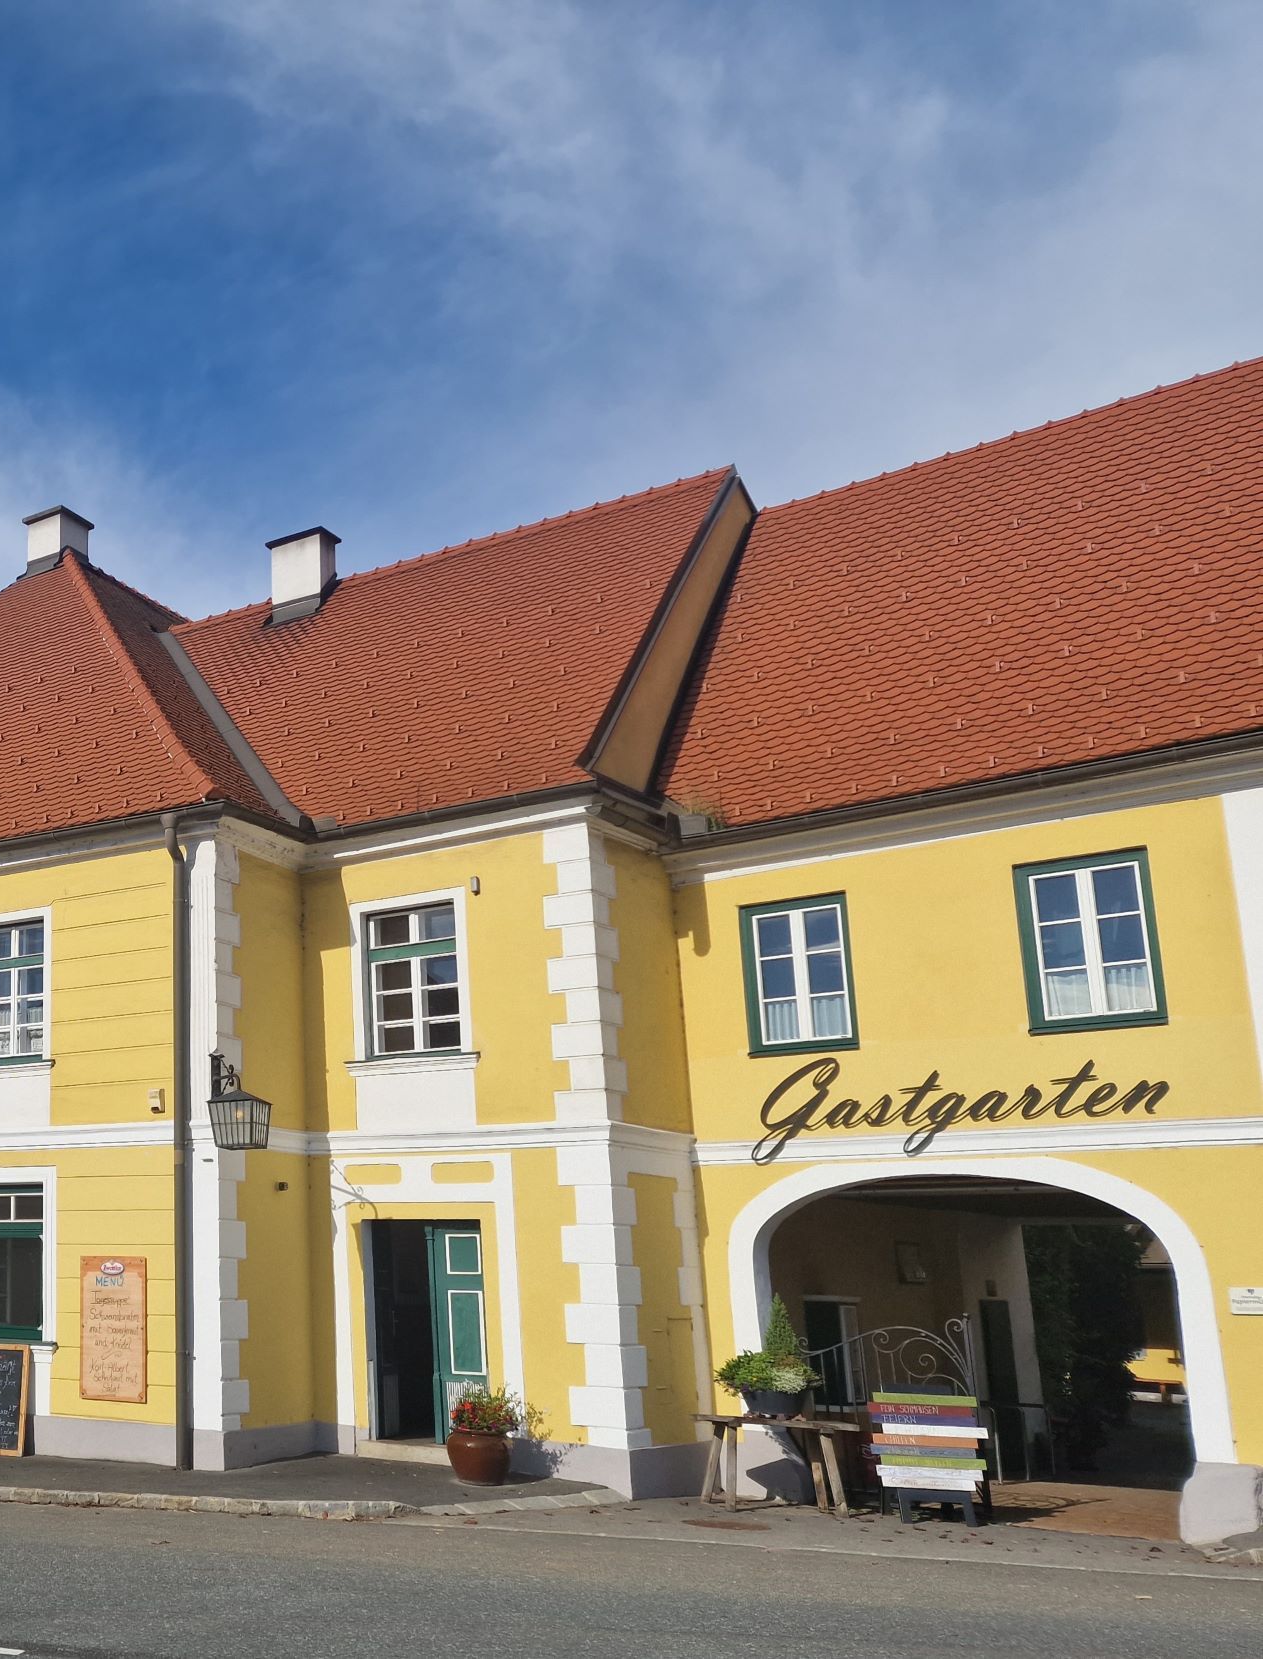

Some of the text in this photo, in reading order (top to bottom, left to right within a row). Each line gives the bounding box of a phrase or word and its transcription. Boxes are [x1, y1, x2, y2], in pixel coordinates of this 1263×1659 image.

[751, 1057, 1170, 1166] Gastgarten
[95, 1275, 124, 1287] MENÜ
[882, 1414, 918, 1424] FEIERN
